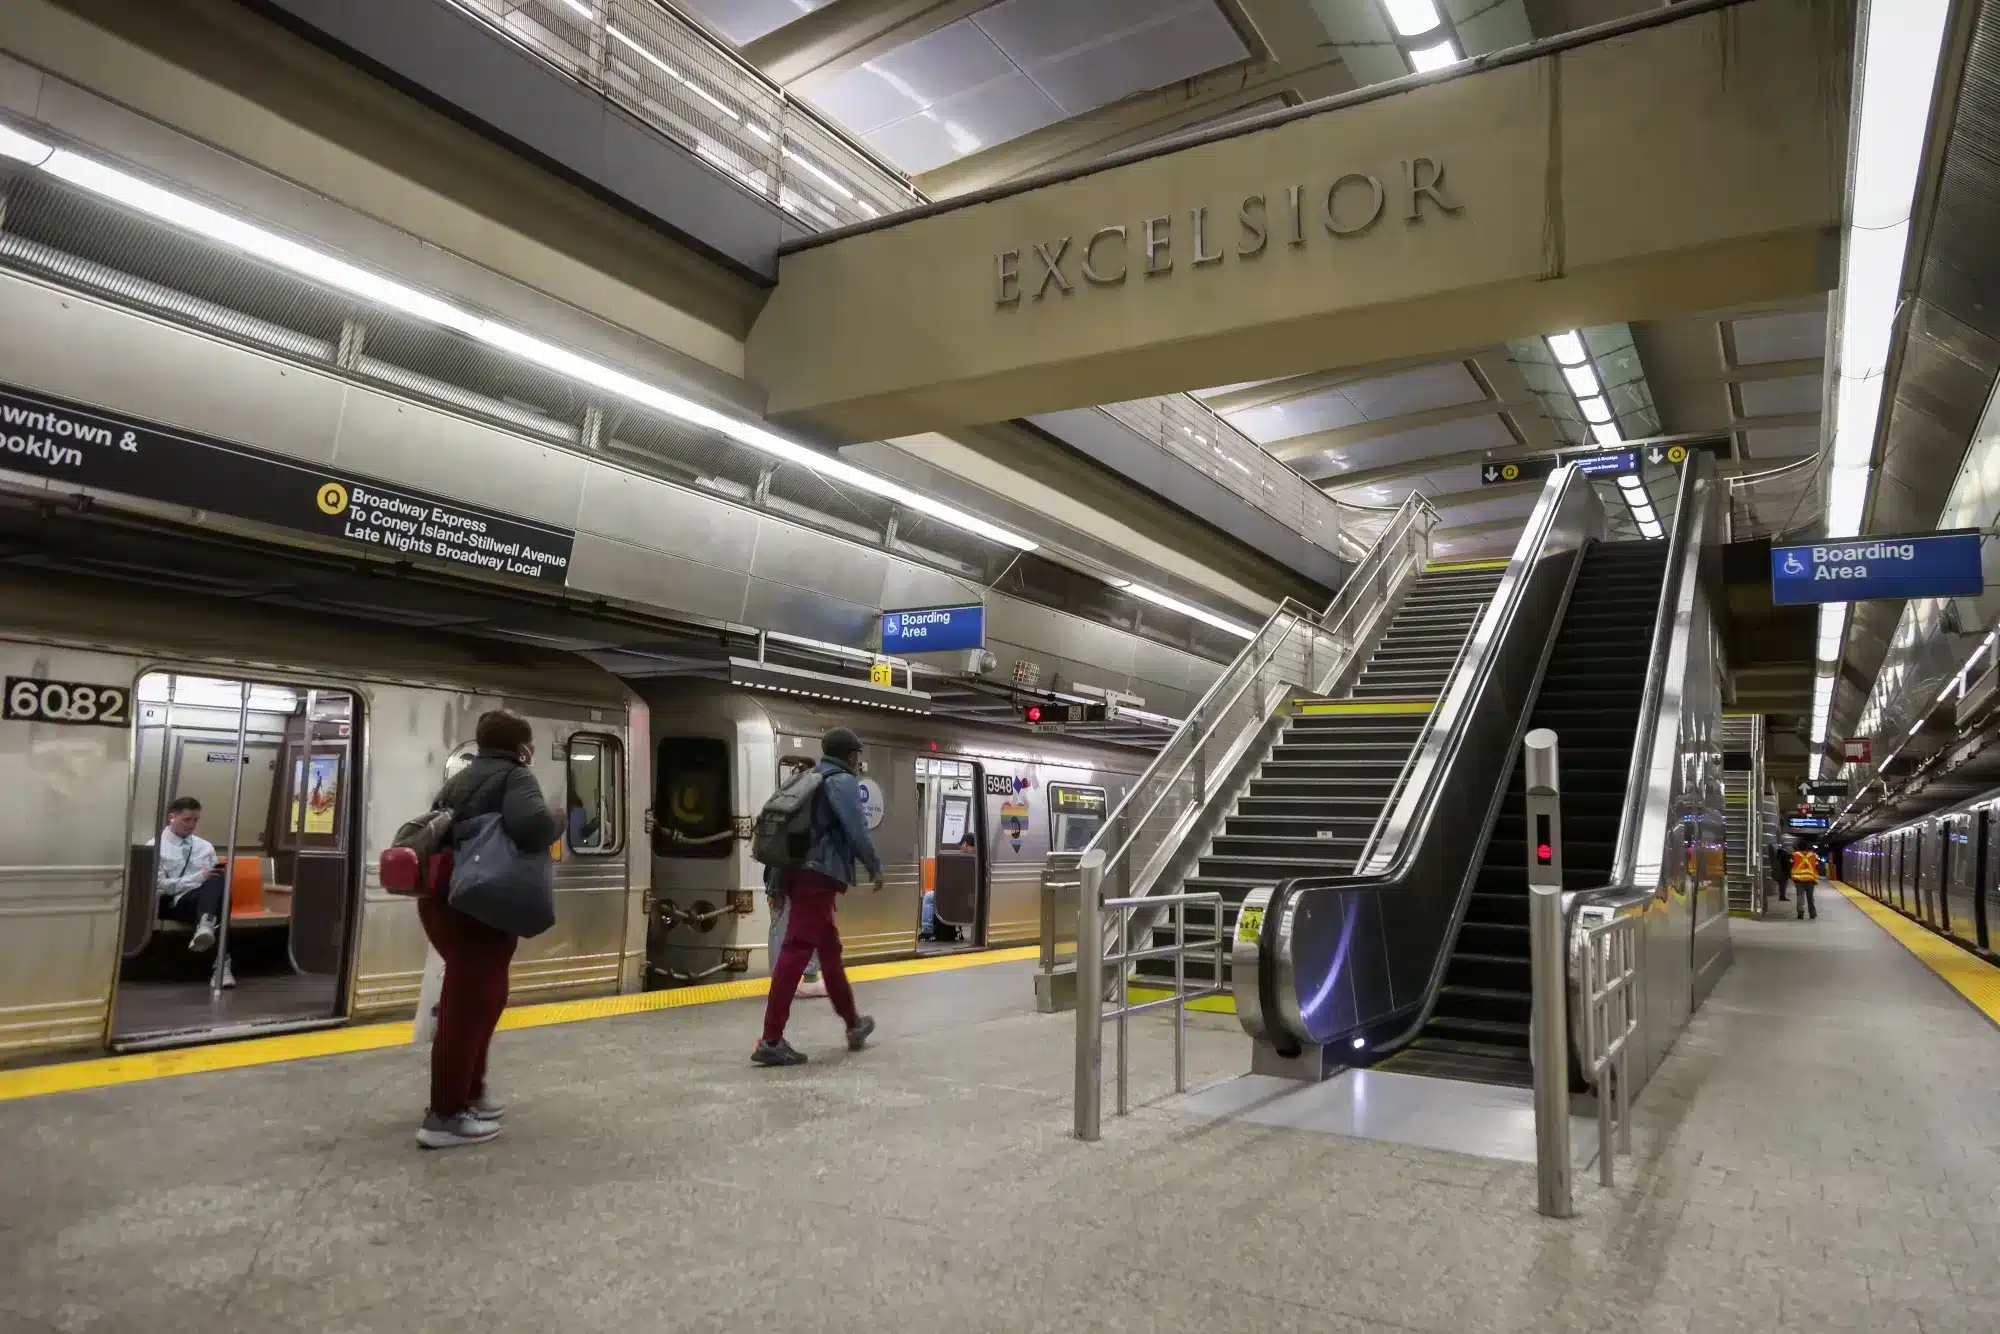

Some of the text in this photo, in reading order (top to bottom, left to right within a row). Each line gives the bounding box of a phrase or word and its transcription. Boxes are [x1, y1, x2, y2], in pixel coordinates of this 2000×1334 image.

[994, 157, 1464, 305] EXCELSIOR
[0, 404, 138, 452] wntown &
[352, 488, 487, 533] Broadway Express
[344, 523, 542, 577] Late Nights Broadway Local
[350, 505, 567, 567] To Coney Island-Stillwell Avenue
[1812, 543, 1915, 563] Boarding
[1814, 564, 1867, 580] Area
[901, 612, 951, 625] Boarding
[901, 626, 927, 638] Area
[10, 681, 124, 722] 6082
[987, 775, 1012, 793] 5948
